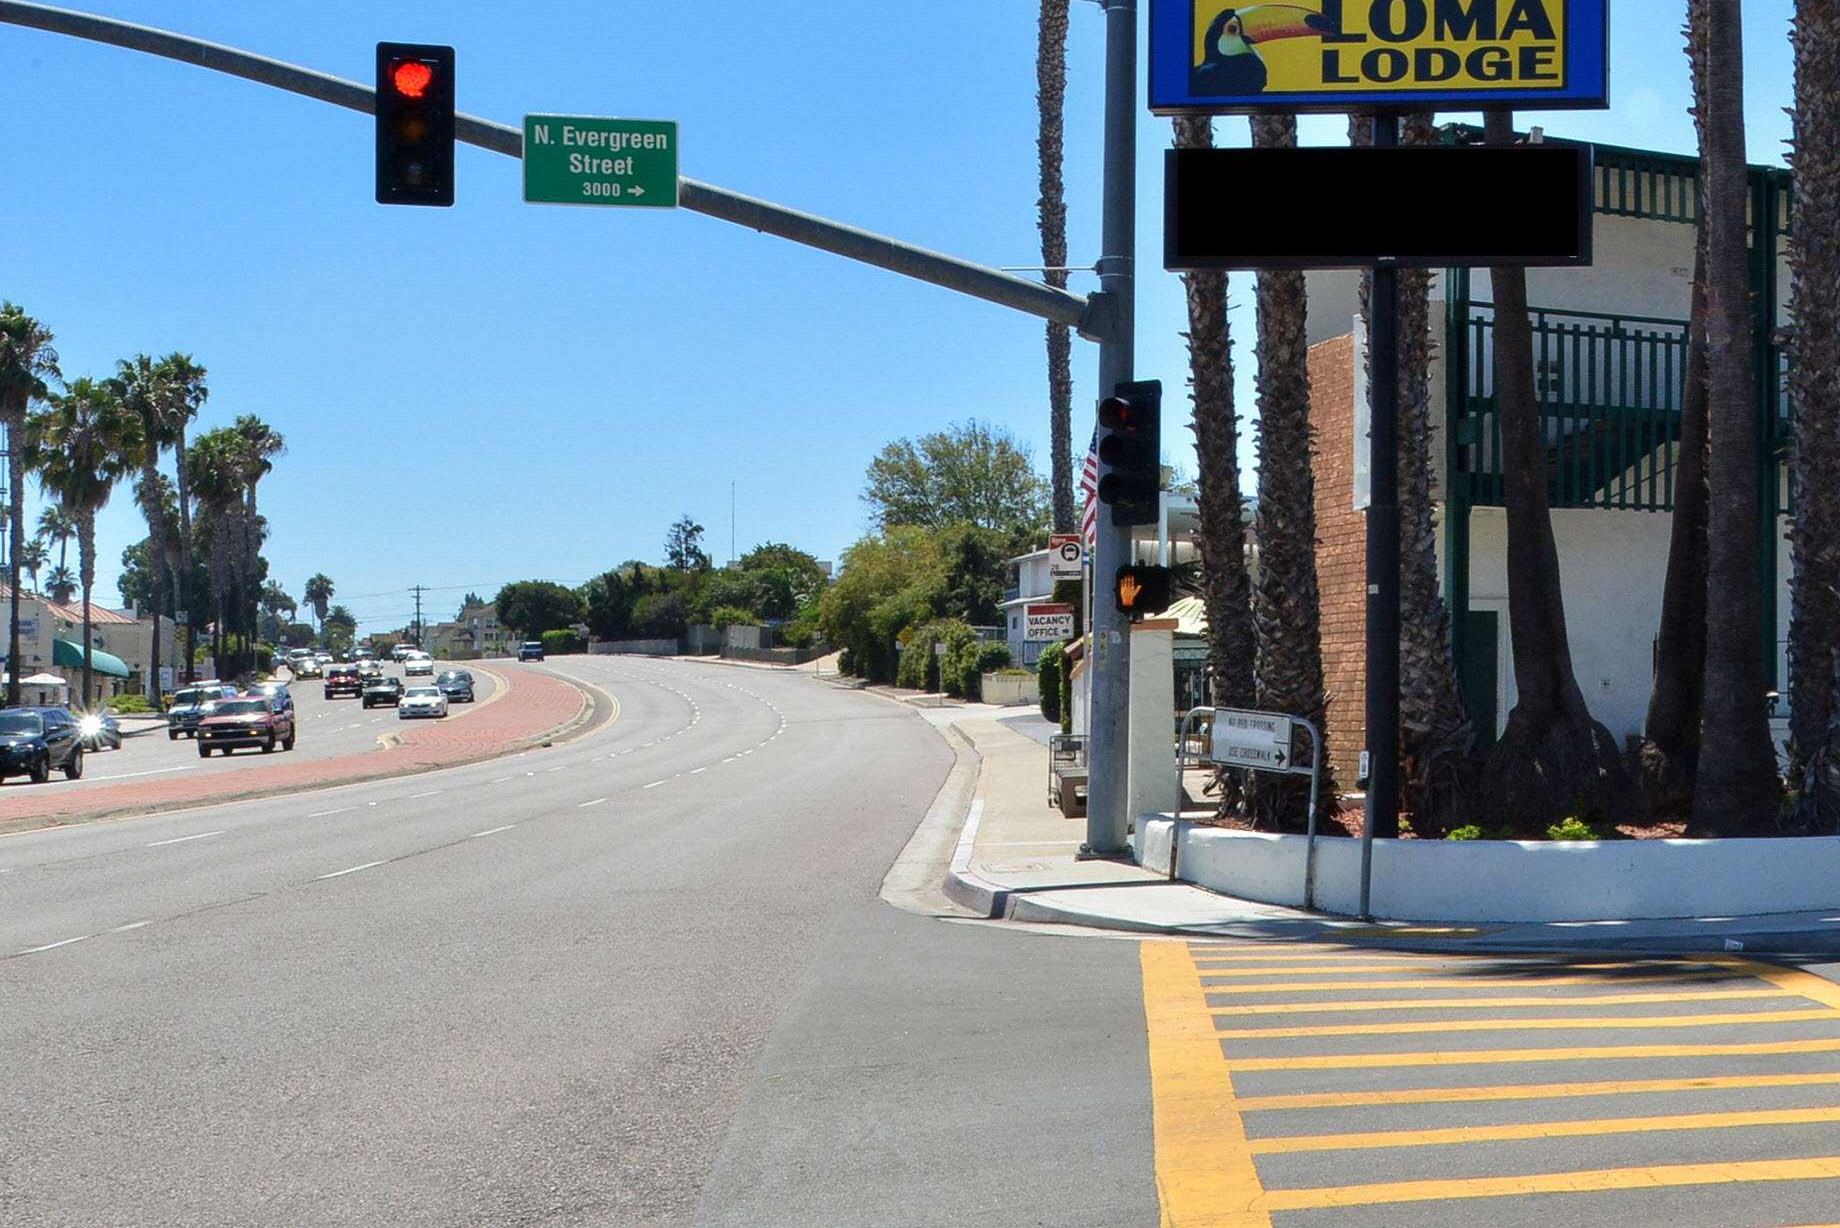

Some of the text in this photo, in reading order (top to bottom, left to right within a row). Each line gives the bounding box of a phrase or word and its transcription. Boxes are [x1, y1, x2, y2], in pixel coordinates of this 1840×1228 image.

[1321, 46, 1559, 84] LODGE
[534, 124, 667, 152] N. Evergreen
[569, 153, 634, 175] Street
[583, 182, 621, 197] 3000
[1028, 615, 1071, 625] VACANCY
[1028, 627, 1059, 637] OFFICE
